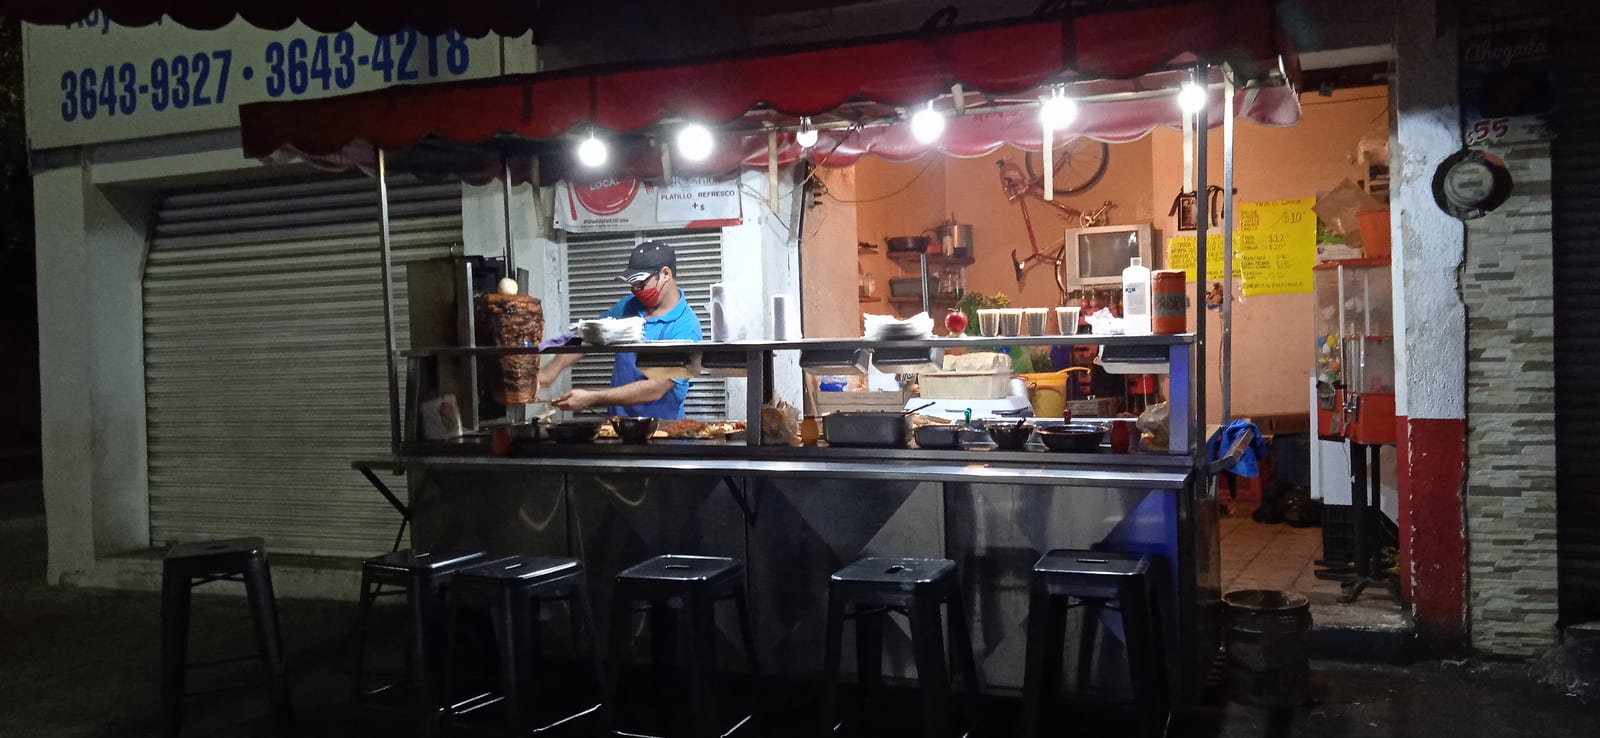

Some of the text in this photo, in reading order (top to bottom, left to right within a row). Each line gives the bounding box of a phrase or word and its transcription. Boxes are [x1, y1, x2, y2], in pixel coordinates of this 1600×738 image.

[61, 27, 470, 122] 3643-9327 3643-4218
[697, 190, 735, 198] REFRESCO
